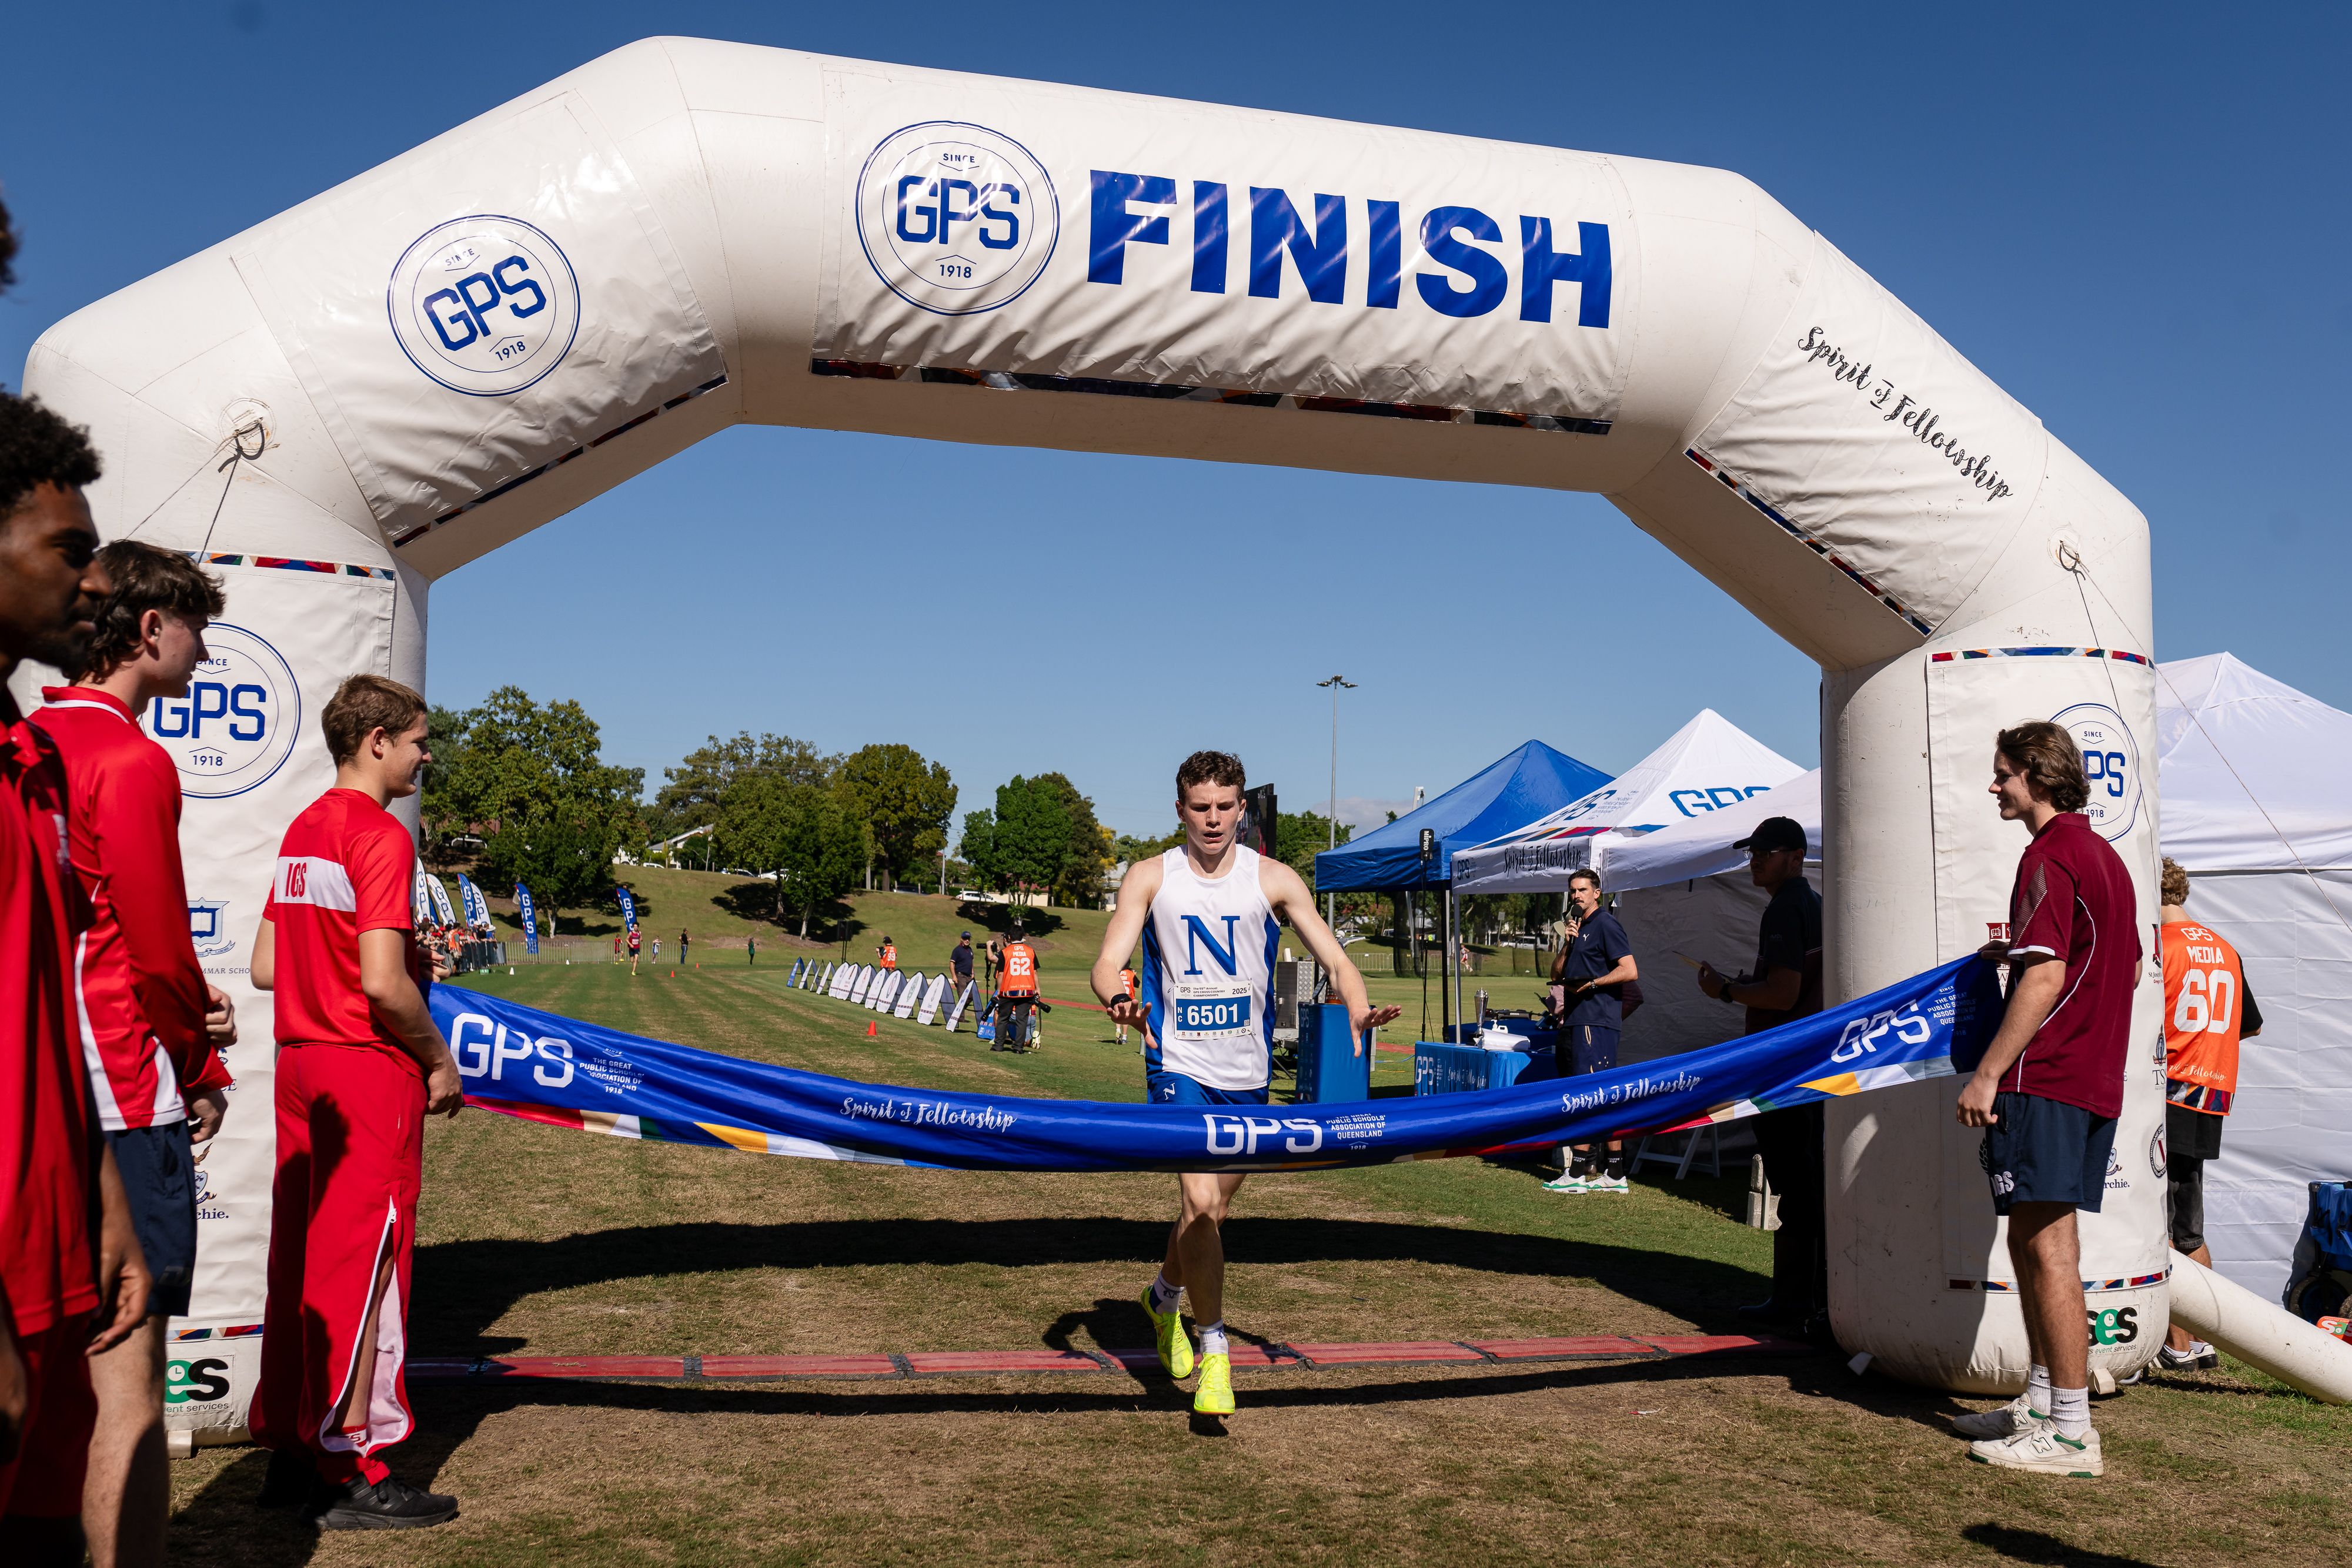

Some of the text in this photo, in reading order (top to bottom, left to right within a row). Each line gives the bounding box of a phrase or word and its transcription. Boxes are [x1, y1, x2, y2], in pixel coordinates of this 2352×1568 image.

[897, 175, 1020, 250] GPS
[1087, 169, 1612, 329] FINISH
[940, 264, 972, 278] 1918
[423, 255, 547, 351] GPS
[495, 340, 526, 362] 1918
[1798, 326, 1872, 390] Spirit
[1883, 394, 2013, 502] Fellowship
[153, 681, 266, 741] GPS
[193, 755, 223, 766] 1918
[2082, 750, 2125, 797] PS
[1457, 858, 1470, 880] GPS
[1504, 845, 1526, 877] Spirit
[1533, 839, 1583, 874] Fellowship
[285, 862, 307, 898] IGS
[522, 894, 534, 934] GPS
[2180, 927, 2214, 941] GPS
[1181, 915, 1240, 976] N
[2186, 945, 2225, 964] MEDIA
[1010, 957, 1031, 976] 62
[1927, 1003, 1950, 1012] PUBLIC
[2173, 968, 2235, 1034] 60
[1187, 1003, 1238, 1025] 6501
[1831, 999, 1931, 1063] GPS
[450, 1012, 574, 1088] GPS
[579, 1062, 607, 1072] PUBLIC
[609, 1061, 632, 1069] GREAT
[1415, 1056, 1434, 1085] GPS
[2152, 1069, 2166, 1085] TS
[604, 1085, 623, 1094] 1918
[1164, 1082, 1175, 1100] N
[1562, 1087, 1608, 1114] Spirit
[1622, 1071, 1703, 1103] Fellowship
[840, 1097, 896, 1119] Spirit
[914, 1102, 1017, 1133] Fellowship
[1202, 1114, 1322, 1155] GPS
[1331, 1122, 1375, 1131] ASSOCIATION
[1337, 1130, 1382, 1140] QUEENSLAND
[2104, 1179, 2130, 1189] rchie.
[2095, 1346, 2113, 1354] event
[2113, 1344, 2137, 1352] services
[186, 1403, 229, 1412] services
